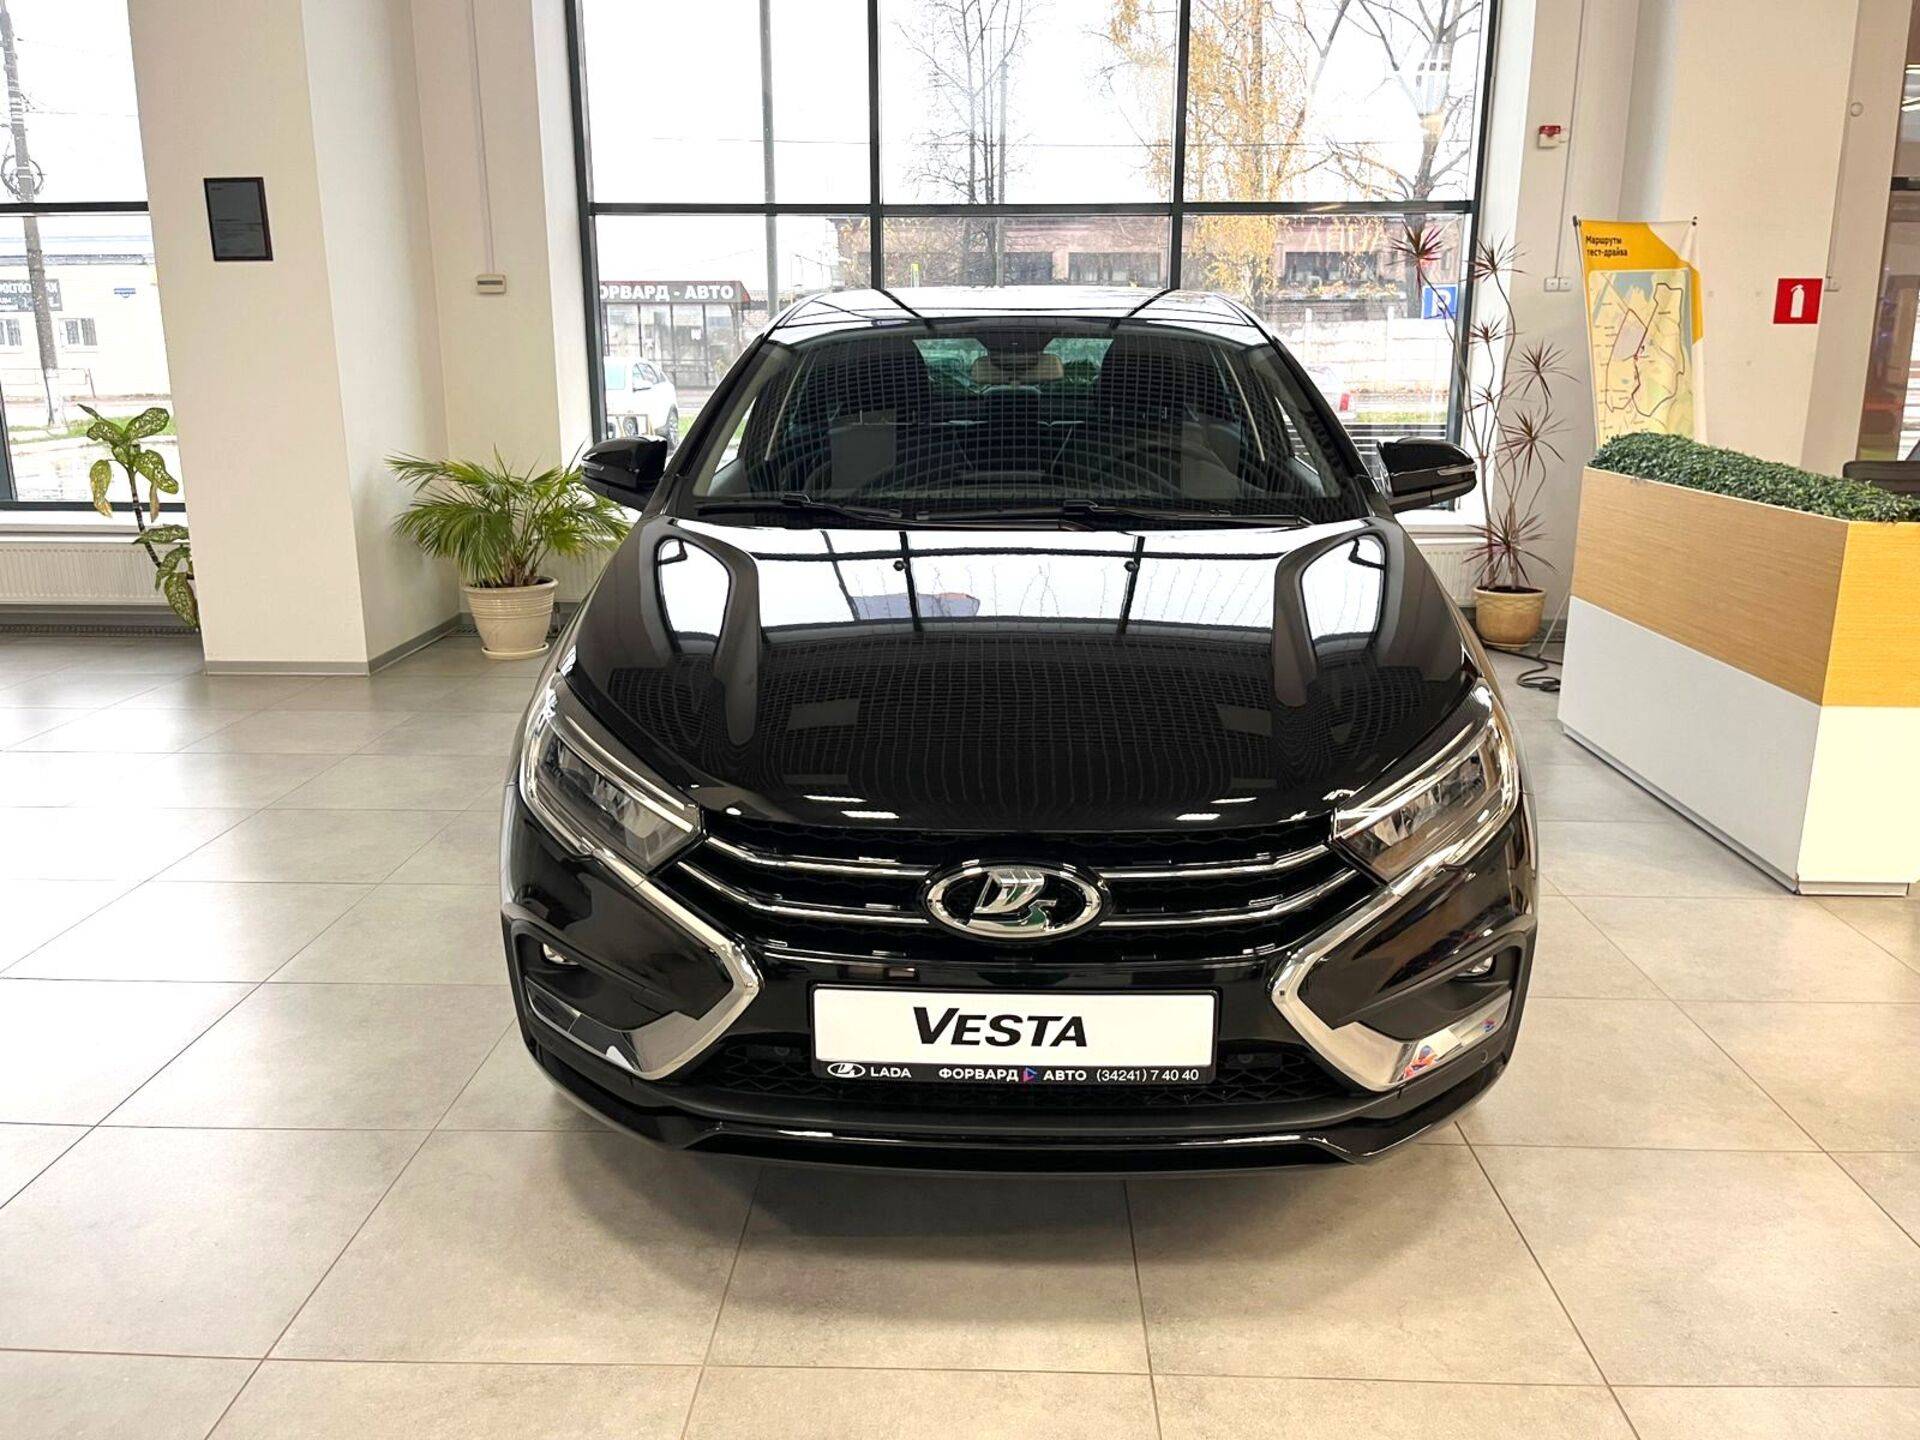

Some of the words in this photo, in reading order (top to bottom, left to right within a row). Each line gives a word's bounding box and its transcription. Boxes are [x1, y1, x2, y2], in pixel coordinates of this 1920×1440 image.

[1585, 235, 1622, 246] Маршруты
[1586, 247, 1628, 258] тест-драйва
[600, 284, 670, 301] ОРВАРД
[685, 285, 734, 299] АВТО
[913, 1006, 1088, 1047] VESTA
[870, 1066, 912, 1079] LADA
[938, 1068, 1019, 1082] ФОРВАРД
[1043, 1070, 1087, 1081] АВТО
[1096, 1068, 1147, 1082] (34241)
[1151, 1070, 1158, 1081] 7
[1161, 1069, 1179, 1081] 40
[1181, 1069, 1200, 1081] 40
